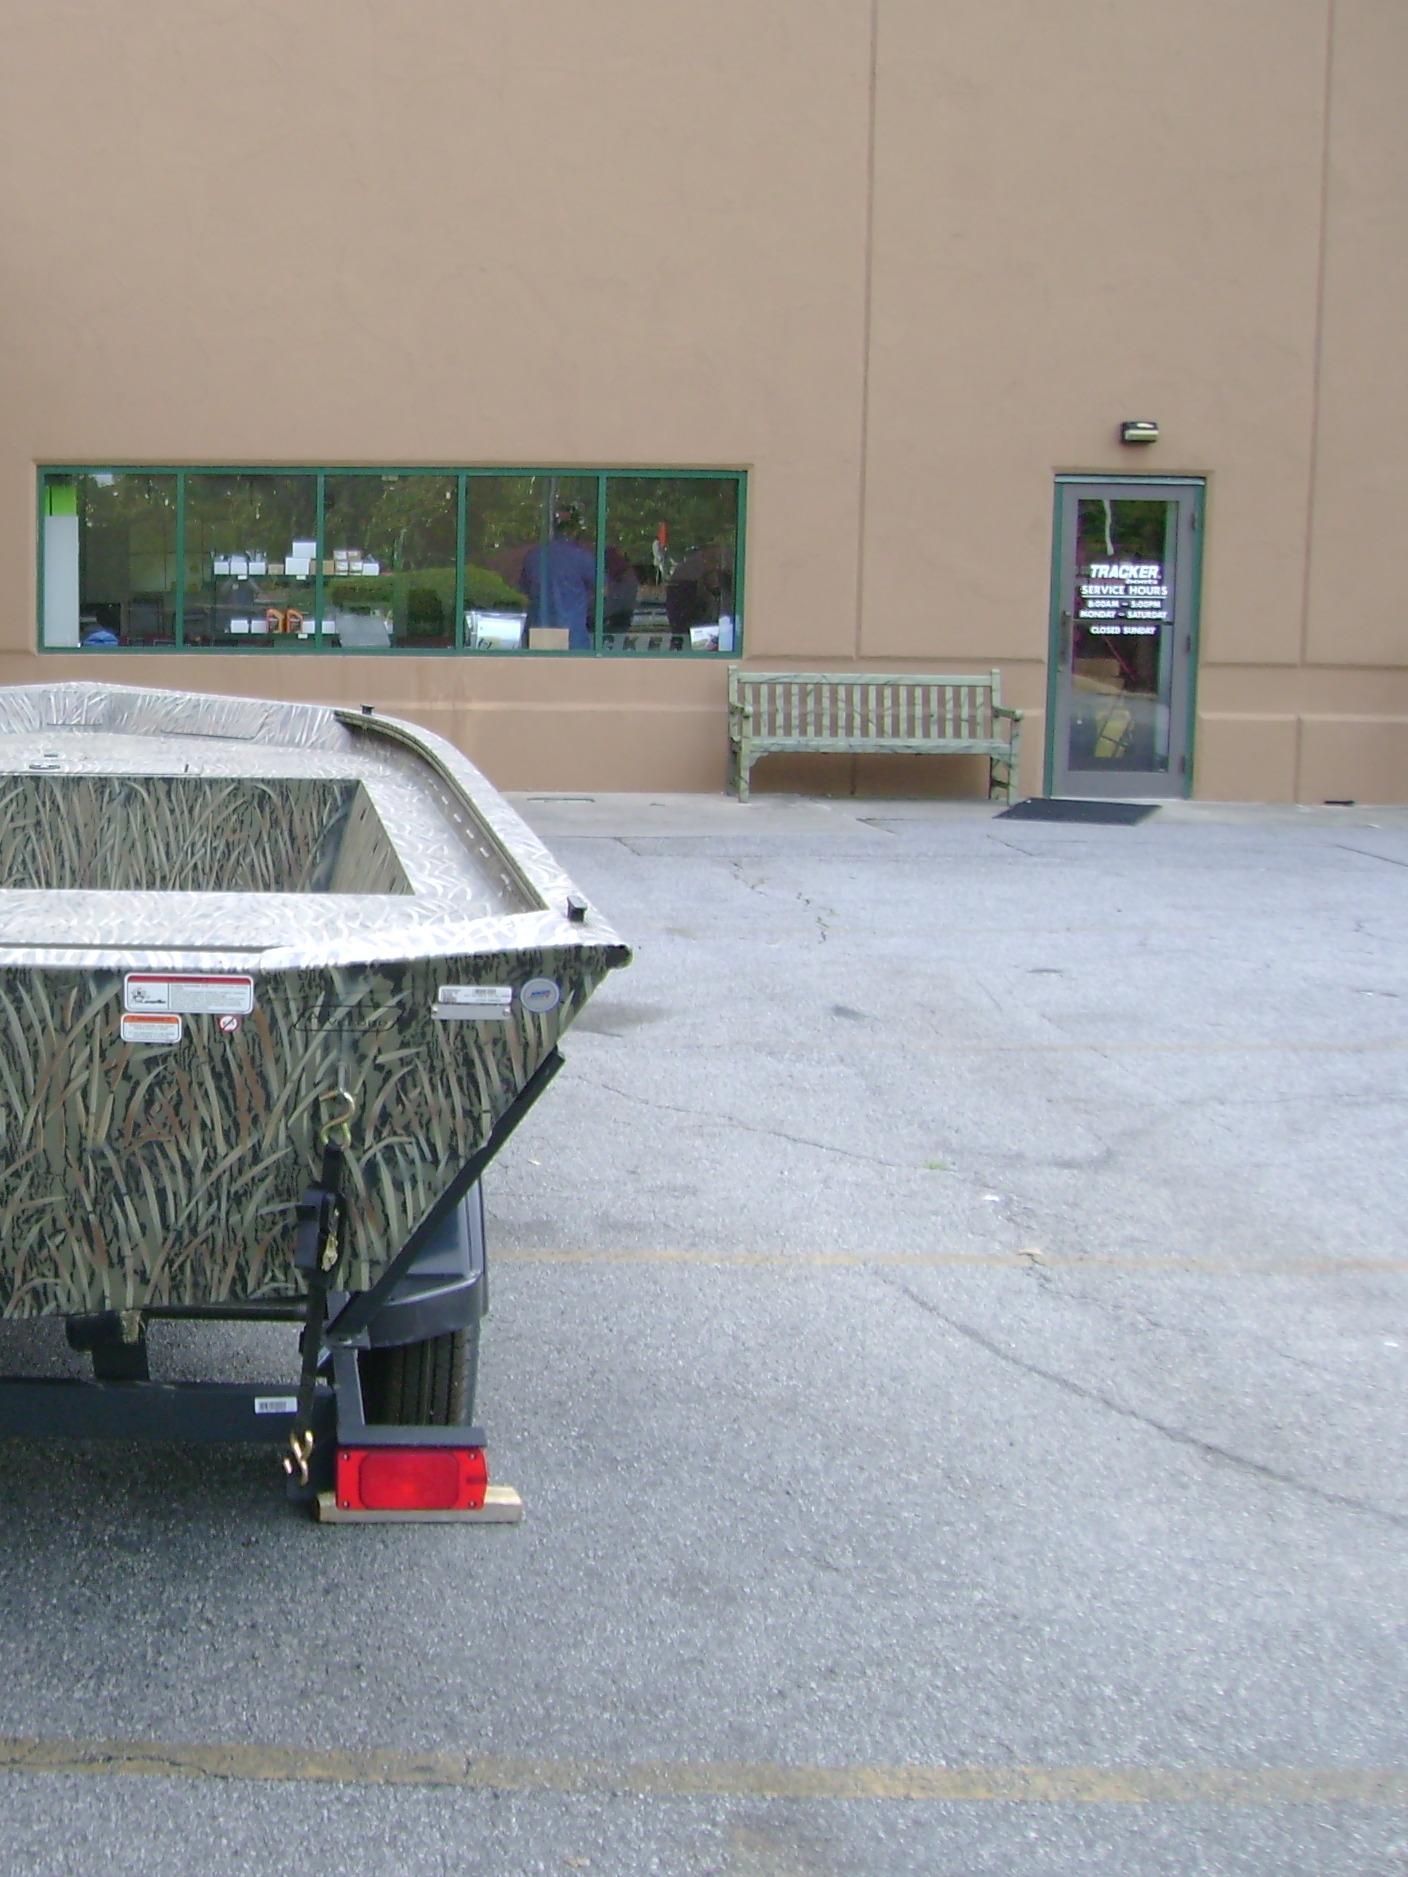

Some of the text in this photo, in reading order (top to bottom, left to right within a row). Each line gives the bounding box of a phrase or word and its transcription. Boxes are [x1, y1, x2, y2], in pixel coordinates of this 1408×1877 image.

[1090, 565, 1159, 579] TRACKER
[1080, 585, 1168, 596] SERVICE HOURS
[1090, 626, 1156, 635] CLOSED SUNDAY
